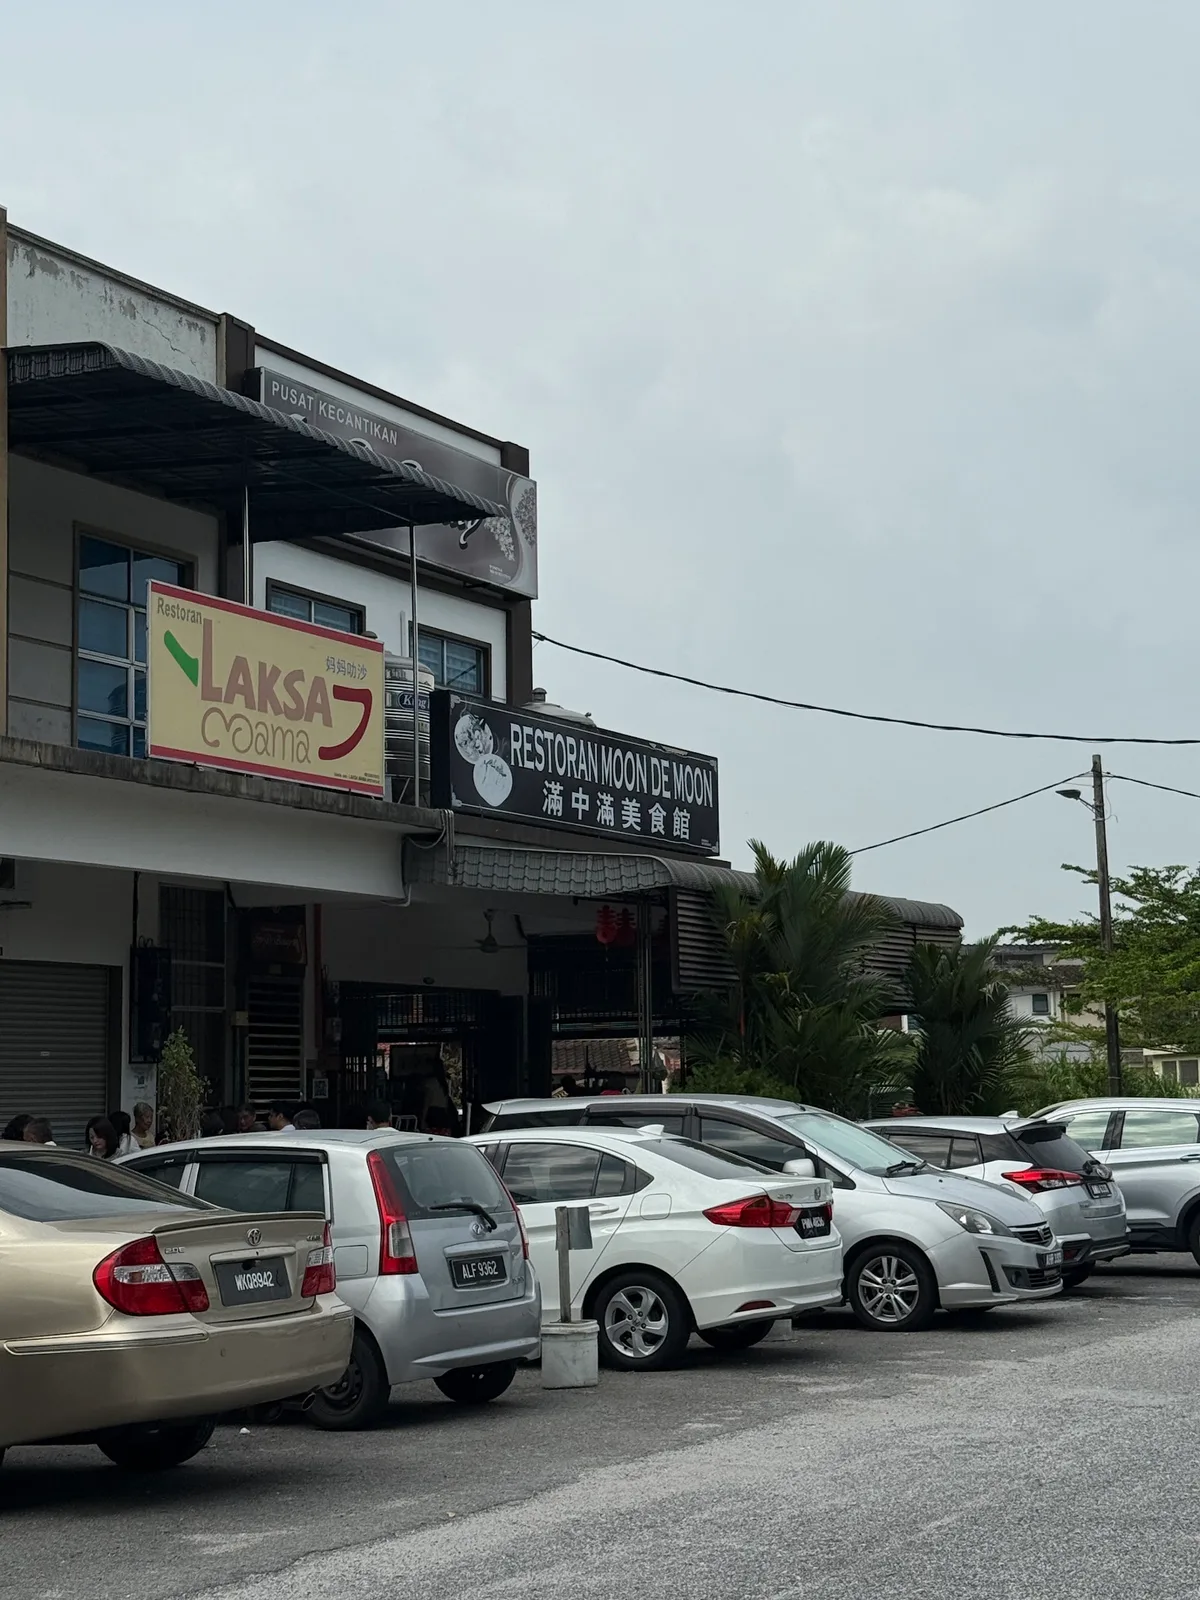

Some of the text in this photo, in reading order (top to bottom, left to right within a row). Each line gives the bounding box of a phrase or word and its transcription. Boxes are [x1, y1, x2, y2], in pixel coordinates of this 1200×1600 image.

[271, 381, 314, 411] PUSAT
[318, 400, 398, 446] KECANTIKAN
[156, 597, 203, 625] Restoran
[200, 618, 333, 729] LAKSA
[325, 655, 368, 681] 妈妈叻沙
[509, 722, 714, 809] RESTORAN MOON DE MOON
[541, 779, 691, 841] 滿中滿美食館
[462, 1260, 499, 1279] ALF 9362
